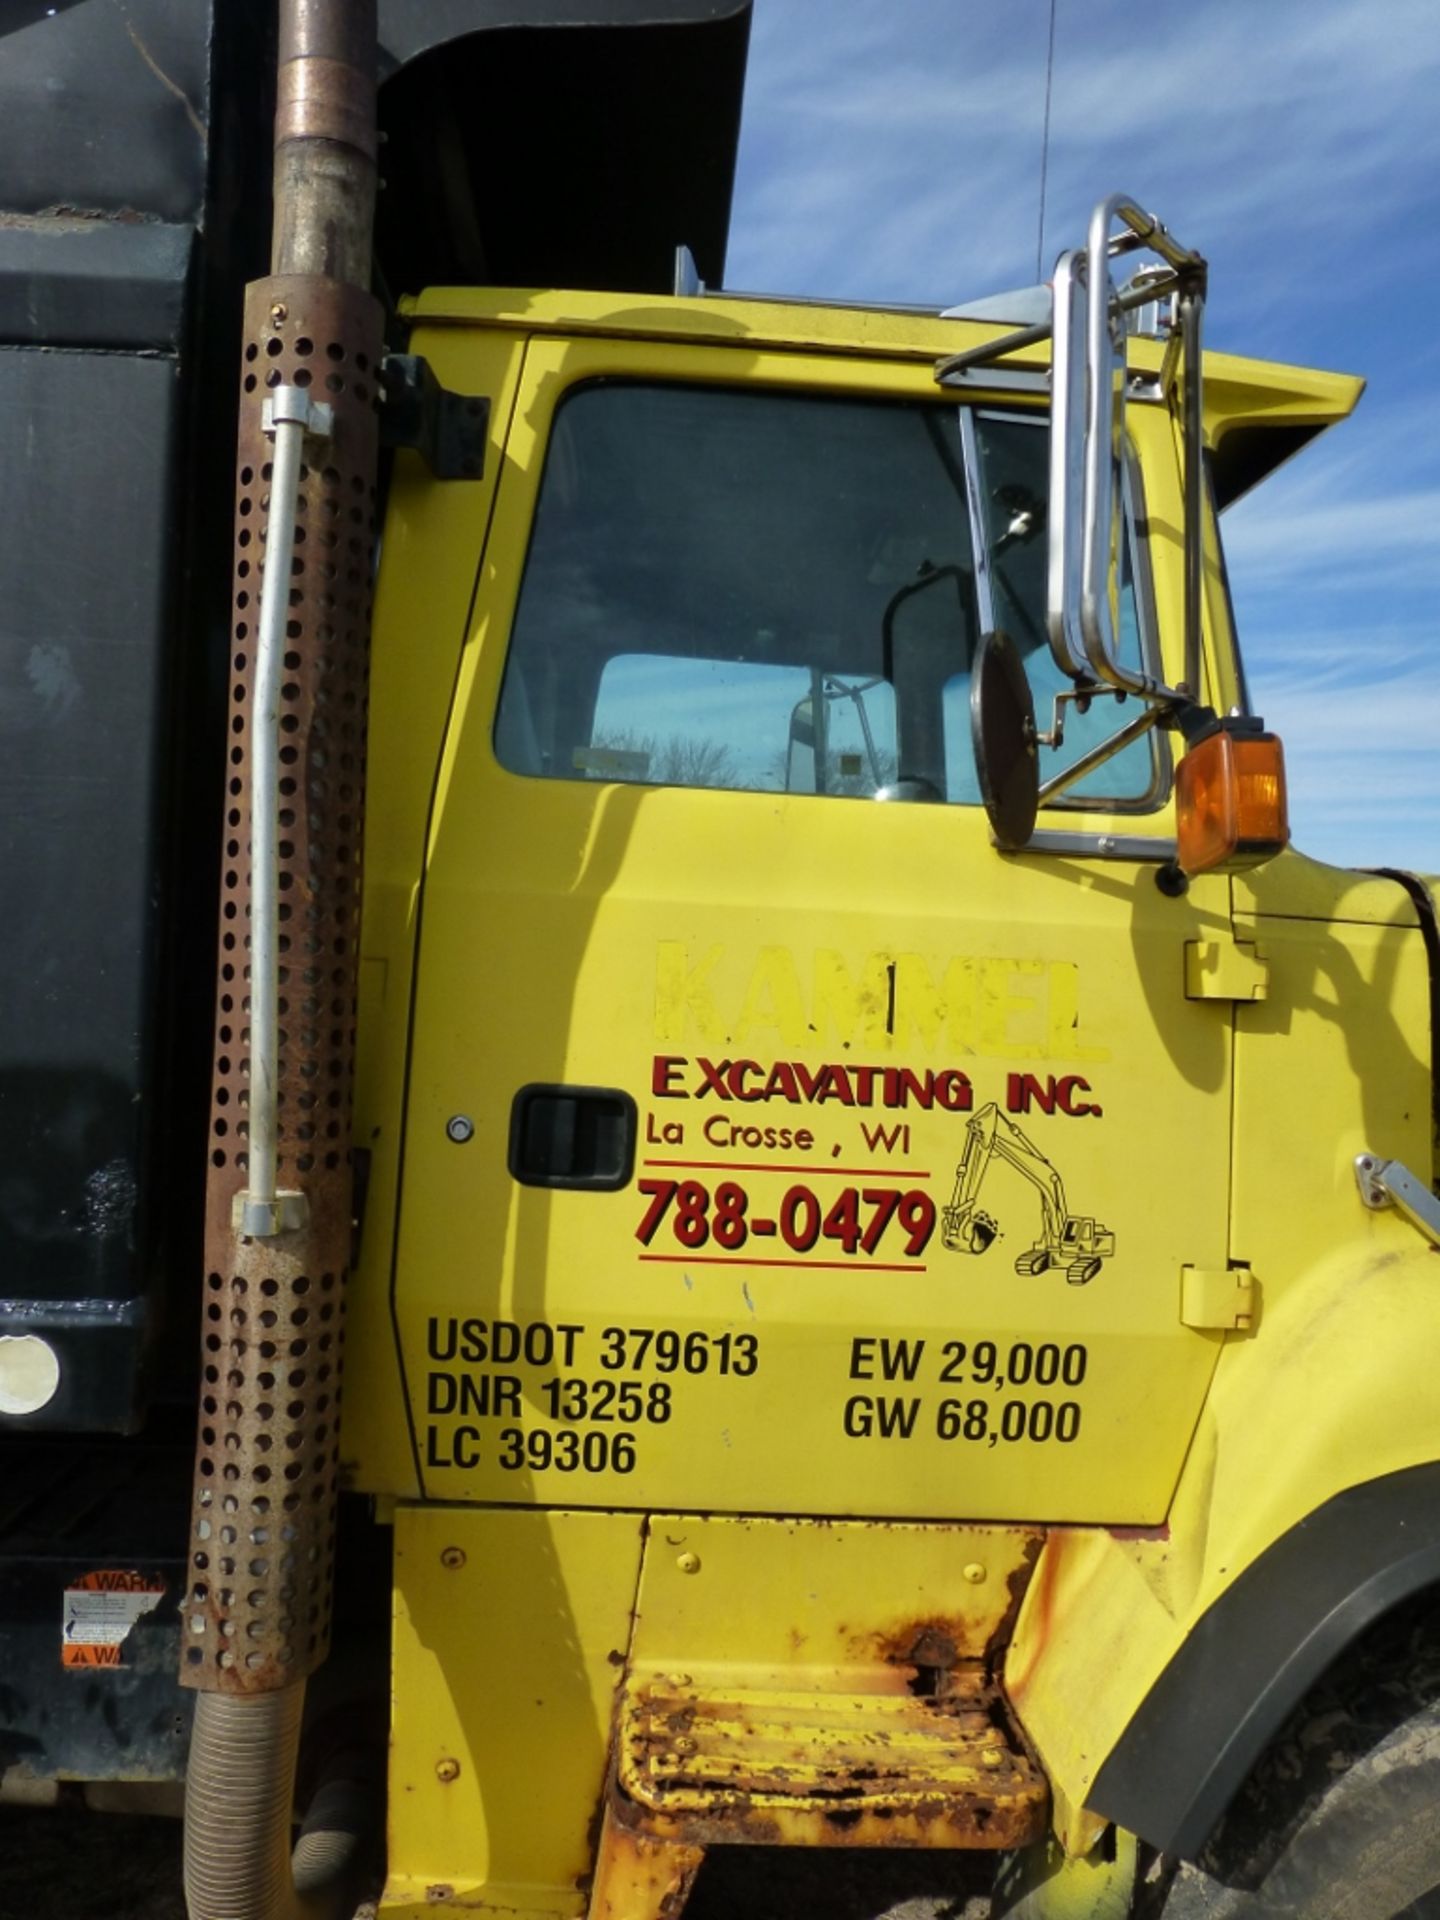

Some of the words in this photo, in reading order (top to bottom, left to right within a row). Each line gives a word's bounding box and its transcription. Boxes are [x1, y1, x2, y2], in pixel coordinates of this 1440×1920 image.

[652, 1055, 974, 1112] EXCAVATING
[1006, 1073, 1103, 1118] INC.
[646, 1112, 684, 1145] La
[703, 1118, 815, 1151] Crosse
[860, 1123, 910, 1154] WI
[635, 1180, 937, 1257] 788-0479
[427, 1317, 584, 1366] USDOT
[600, 1327, 760, 1377] 379613
[849, 1337, 926, 1381] EW
[939, 1341, 1088, 1392] 29,000
[427, 1372, 522, 1418] DNR
[541, 1378, 673, 1424] 13258
[843, 1395, 921, 1439] GW
[936, 1399, 1082, 1448] 68,000
[427, 1425, 481, 1469] LC
[498, 1428, 636, 1474] 39306
